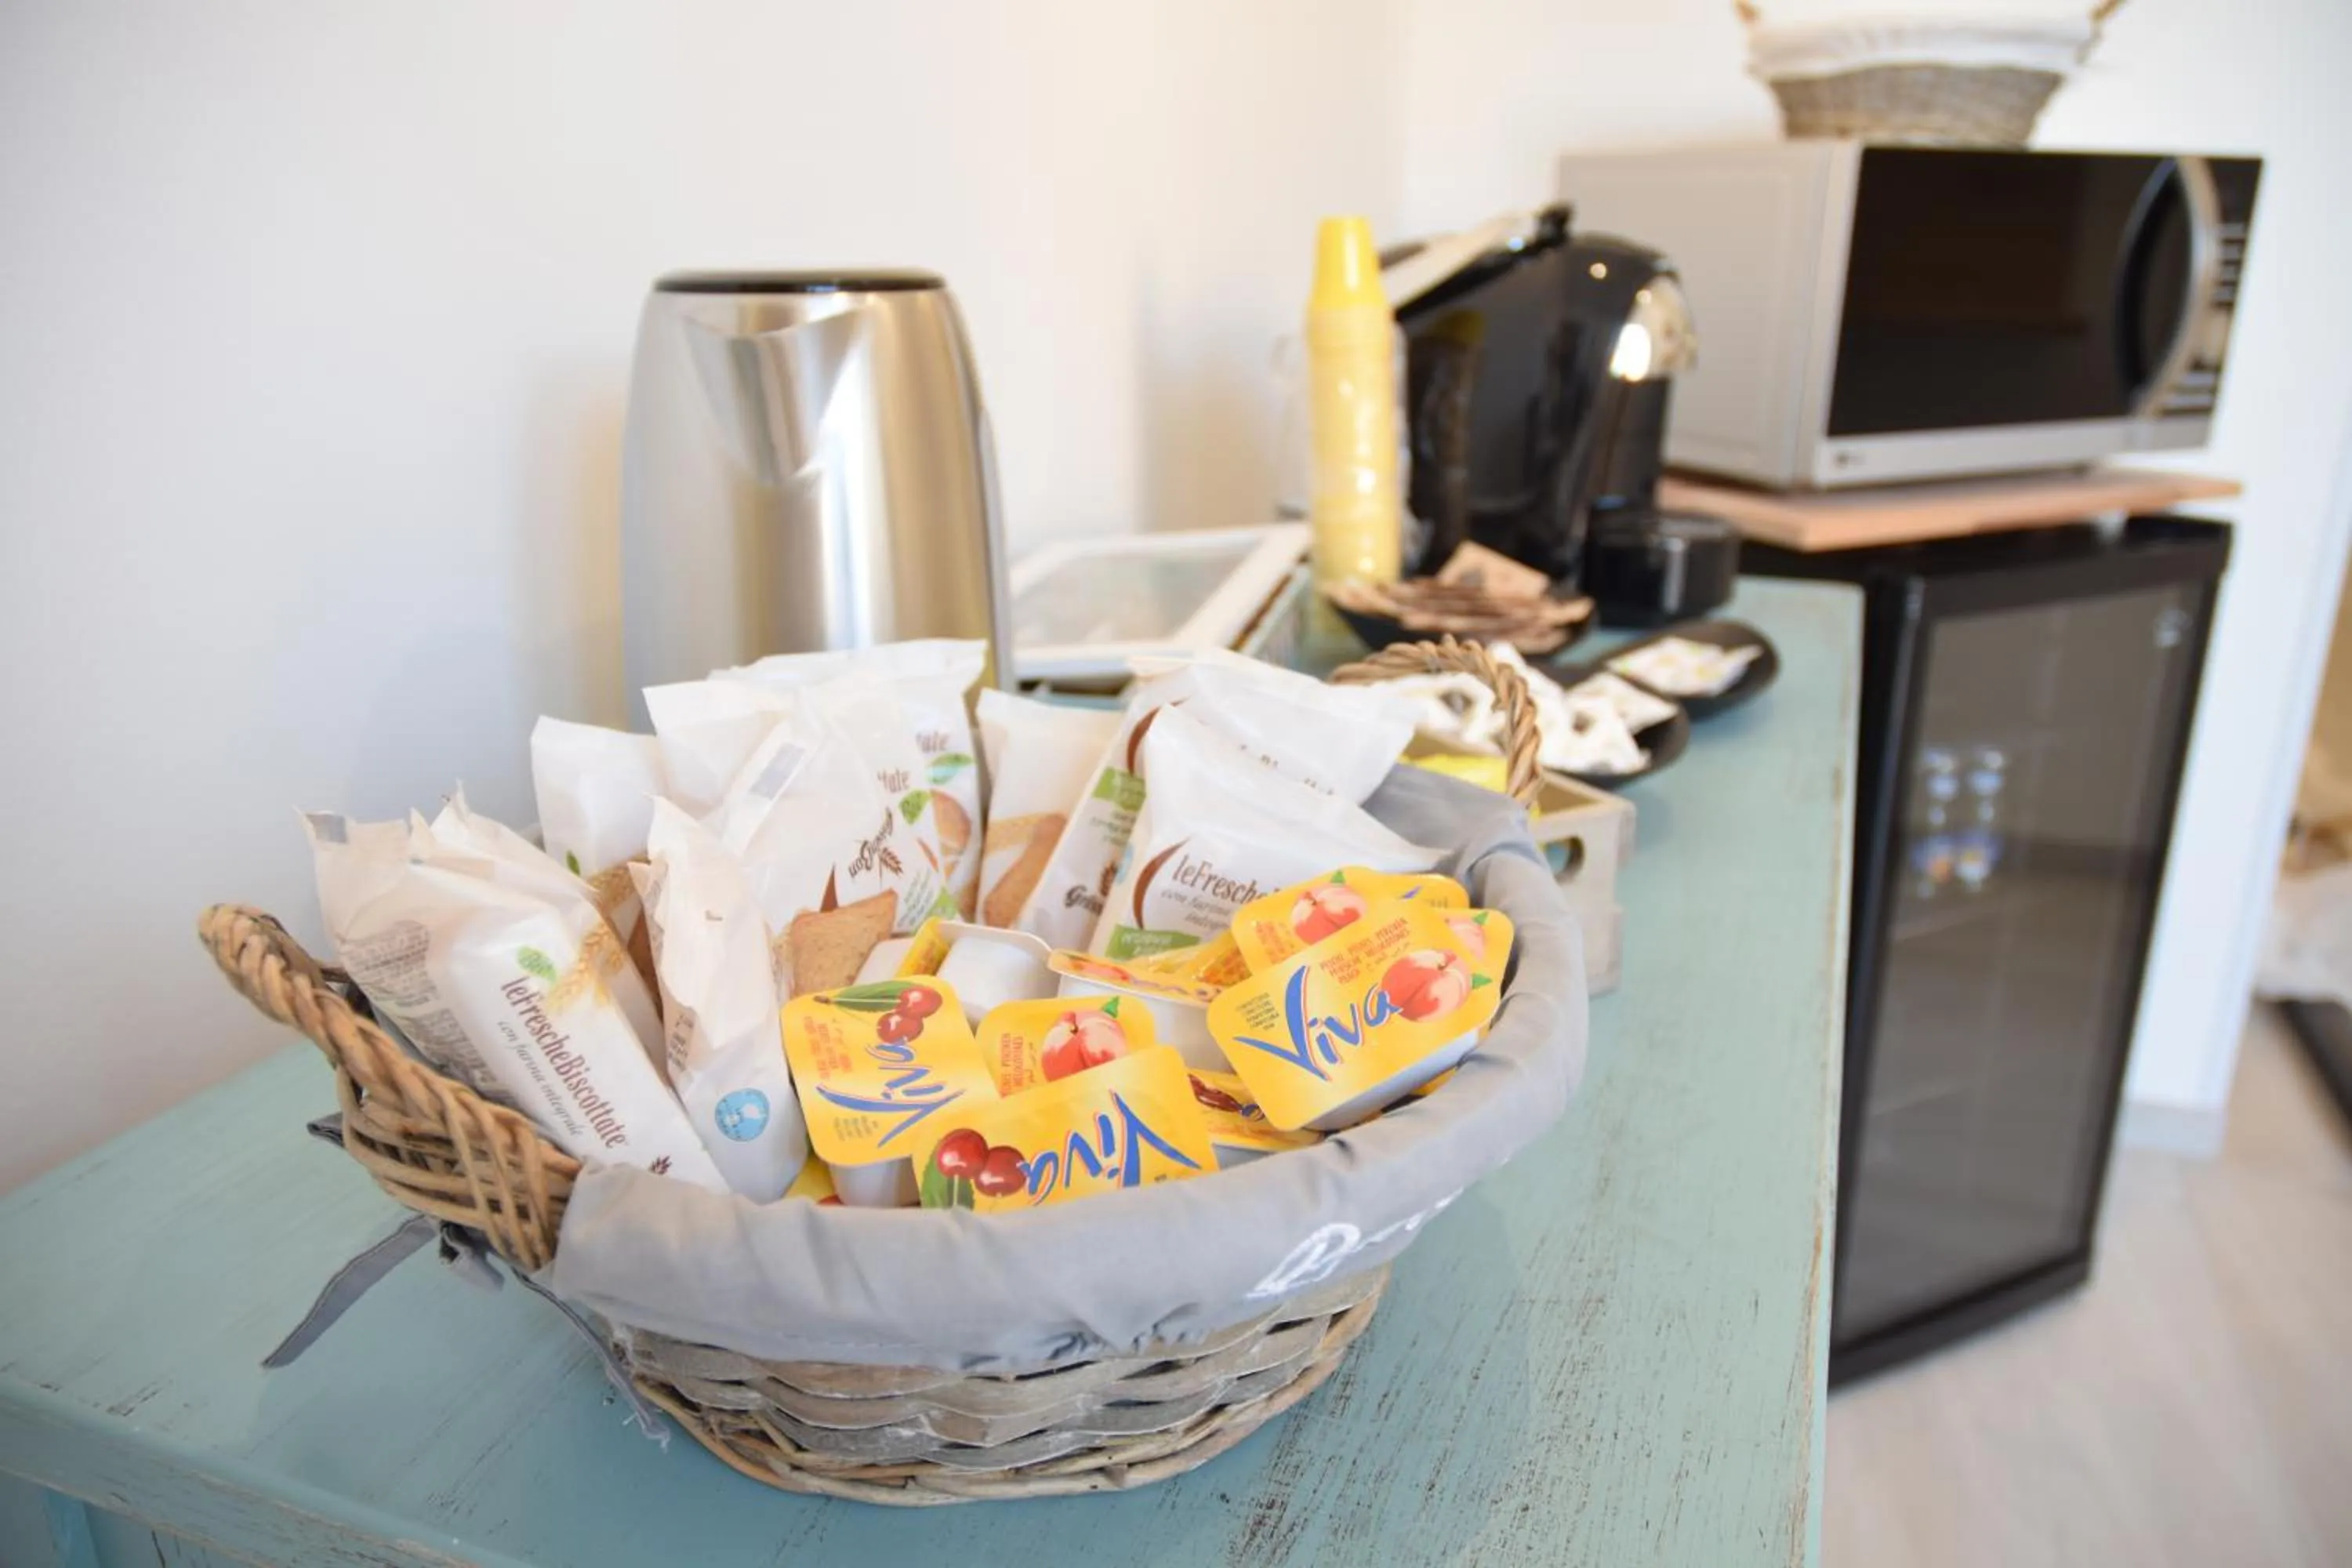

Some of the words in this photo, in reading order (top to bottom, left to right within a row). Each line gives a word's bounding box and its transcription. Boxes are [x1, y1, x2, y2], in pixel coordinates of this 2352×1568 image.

[501, 975, 628, 1150] leFrescheBiscottate
[1233, 965, 1401, 1081] Viva
[816, 1036, 966, 1149] Viva
[1020, 1088, 1201, 1206] Viva
